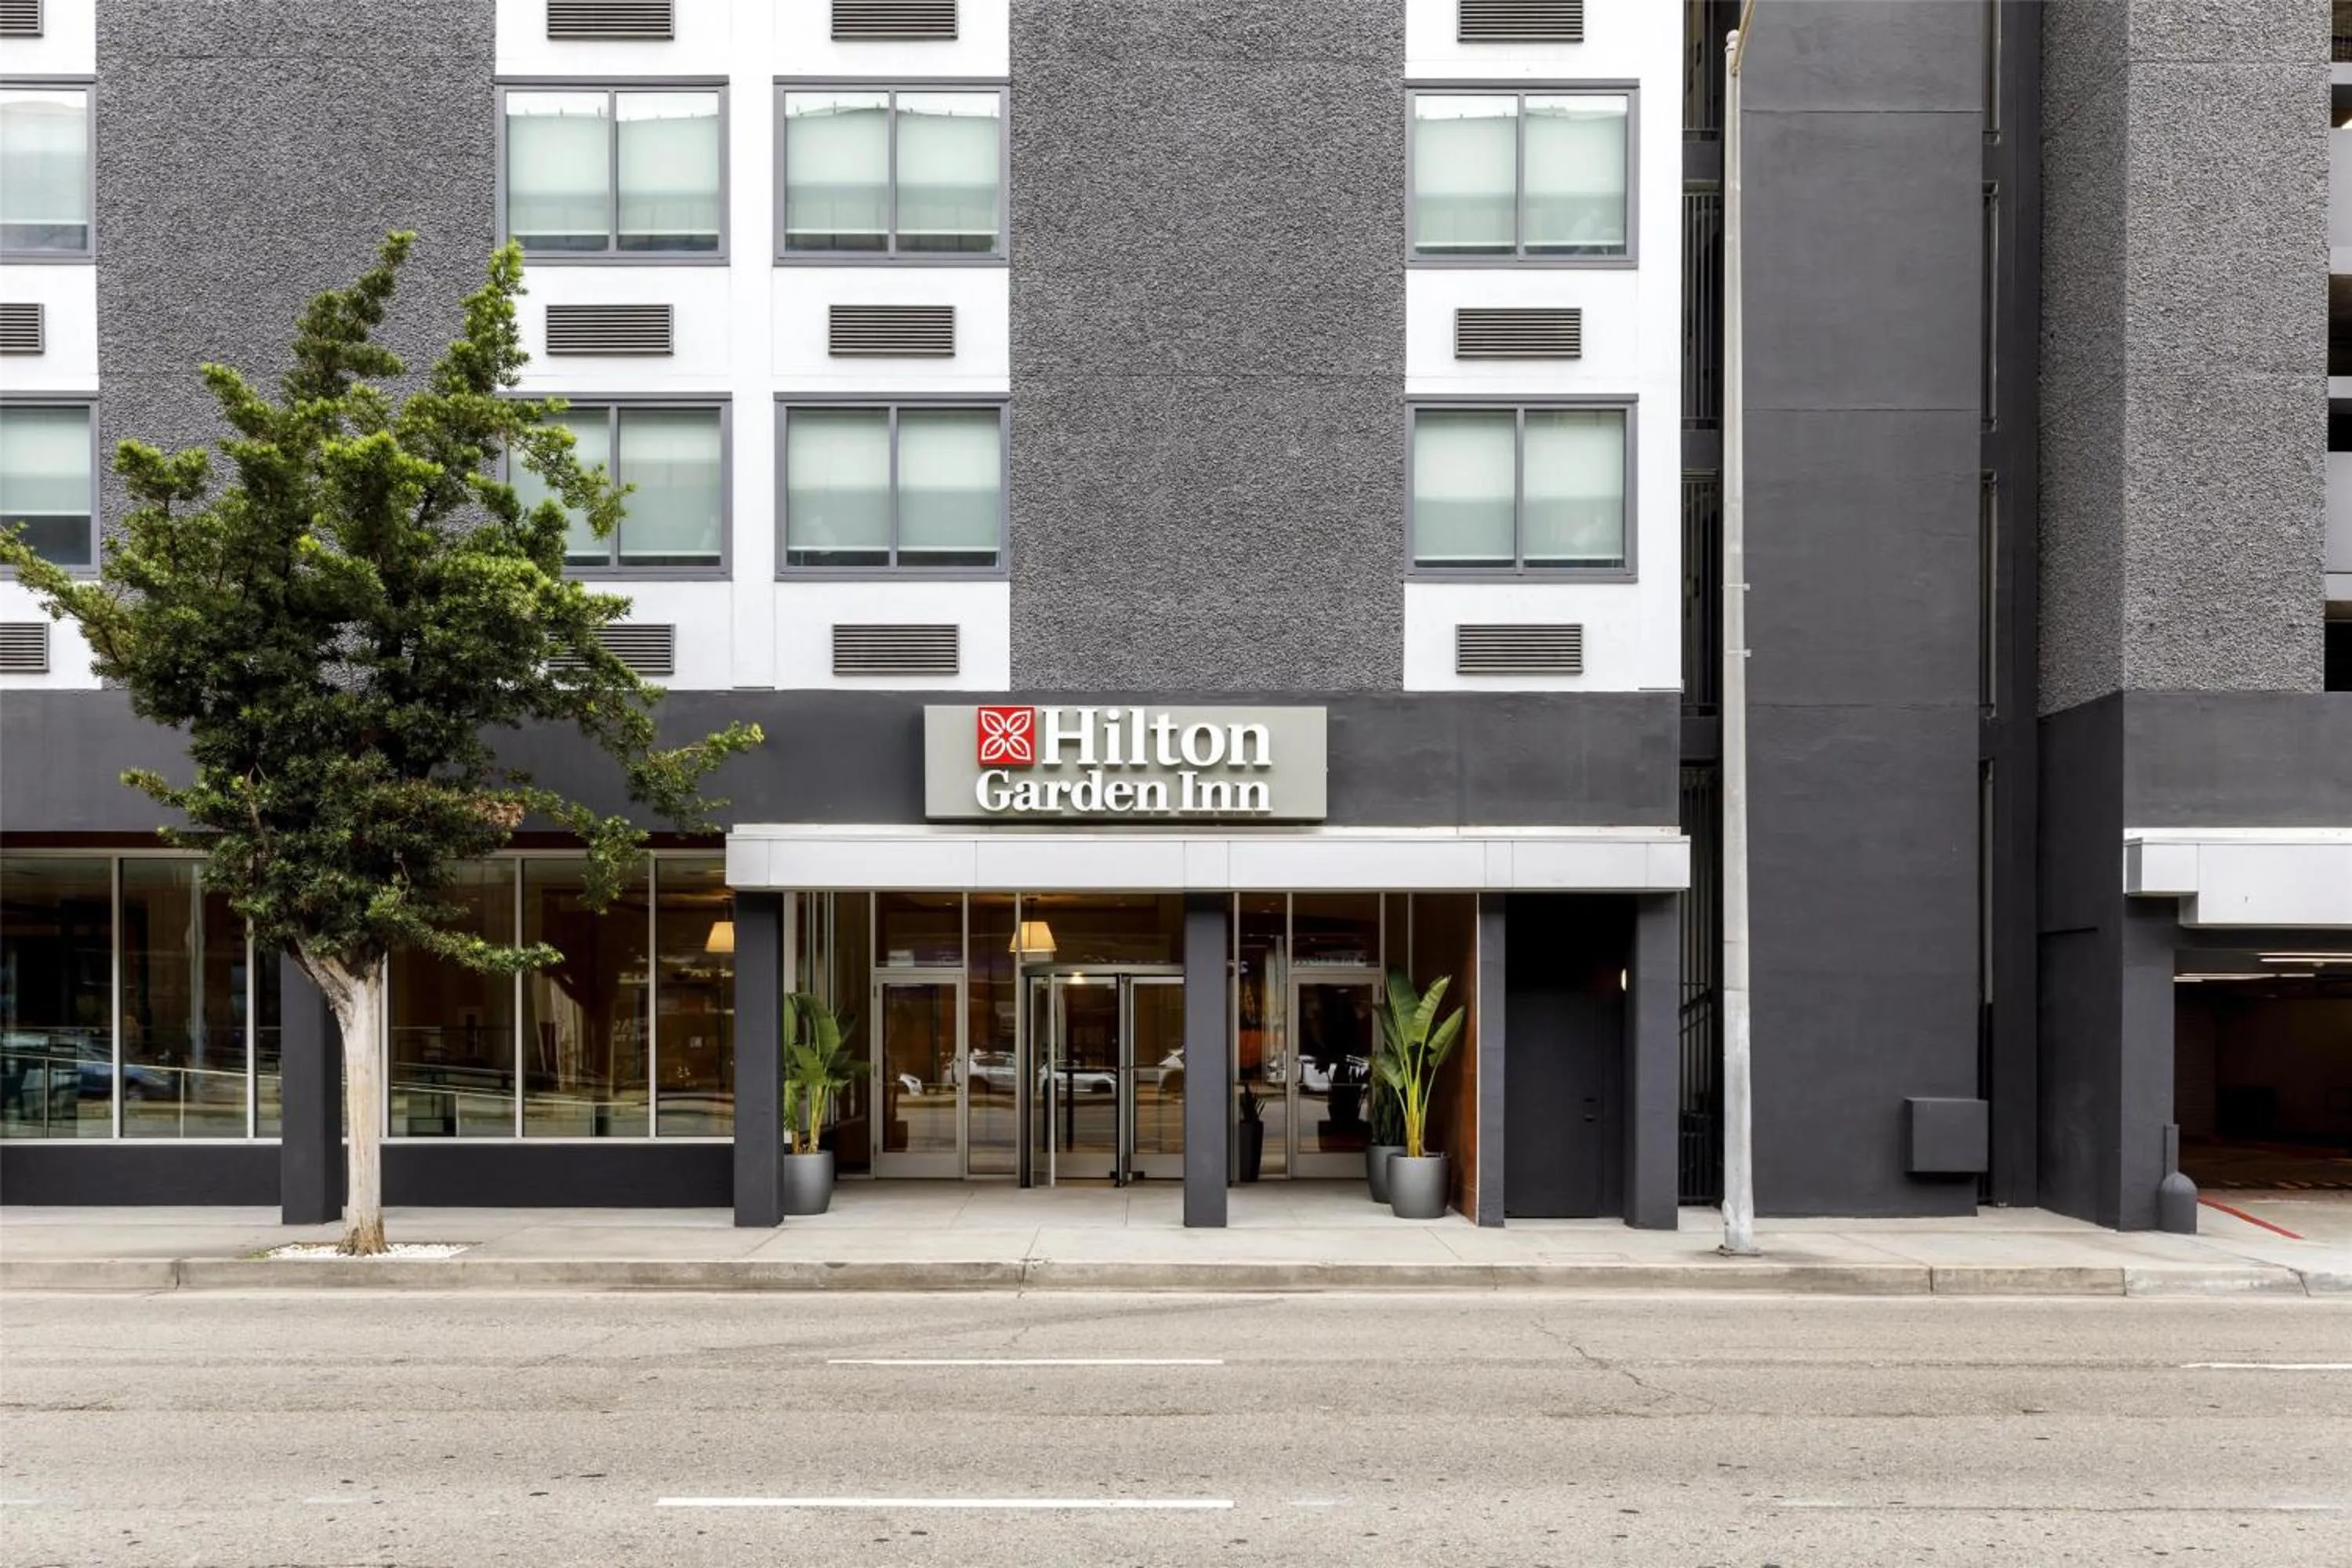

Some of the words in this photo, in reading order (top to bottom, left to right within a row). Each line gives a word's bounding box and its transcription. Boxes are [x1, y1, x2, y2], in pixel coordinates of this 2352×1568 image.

[1041, 706, 1272, 767] Hilton
[975, 769, 1171, 812] Garden
[1178, 771, 1273, 812] Inn
